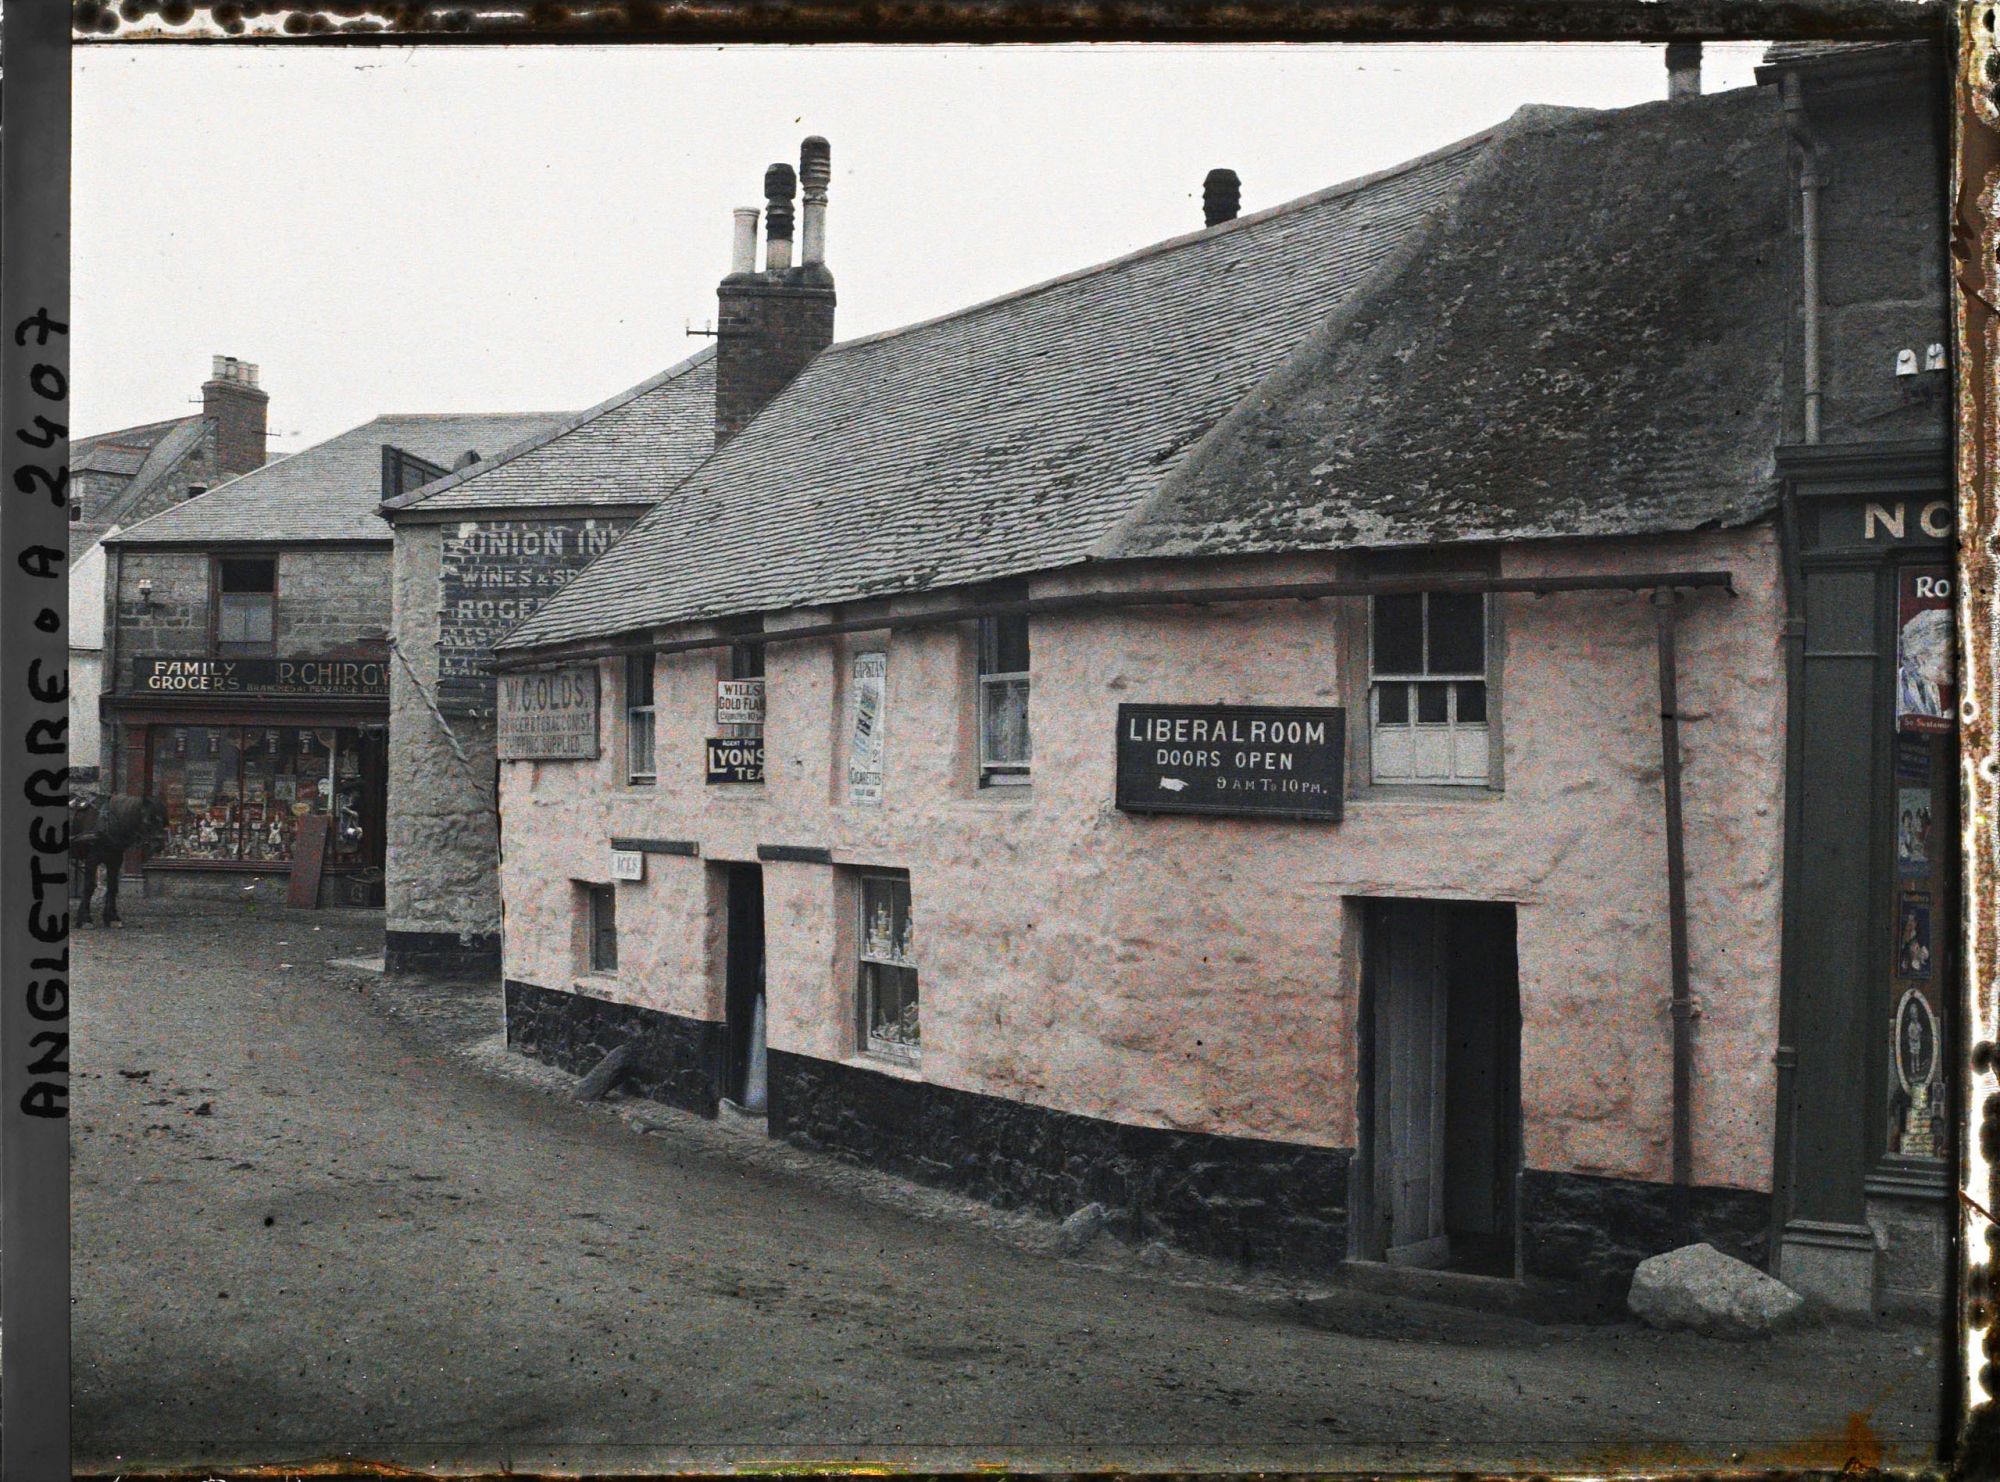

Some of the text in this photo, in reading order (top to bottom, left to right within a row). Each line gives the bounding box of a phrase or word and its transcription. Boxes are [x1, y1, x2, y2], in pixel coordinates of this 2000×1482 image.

[13, 307, 69, 507] 2407
[471, 531, 563, 555] UNION
[17, 545, 65, 579] A
[462, 569, 533, 588] WINES
[155, 661, 237, 677] FAMILY
[149, 675, 240, 690] GROCERS
[719, 696, 741, 710] GOLD
[1129, 718, 1325, 745] LIBERAL ROOM
[708, 747, 764, 773] LYONS
[1156, 749, 1293, 770] DOORS OPEN
[1216, 776, 1227, 790] 9
[1282, 779, 1298, 792] 10
[20, 658, 69, 1118] ANGLETERRE
